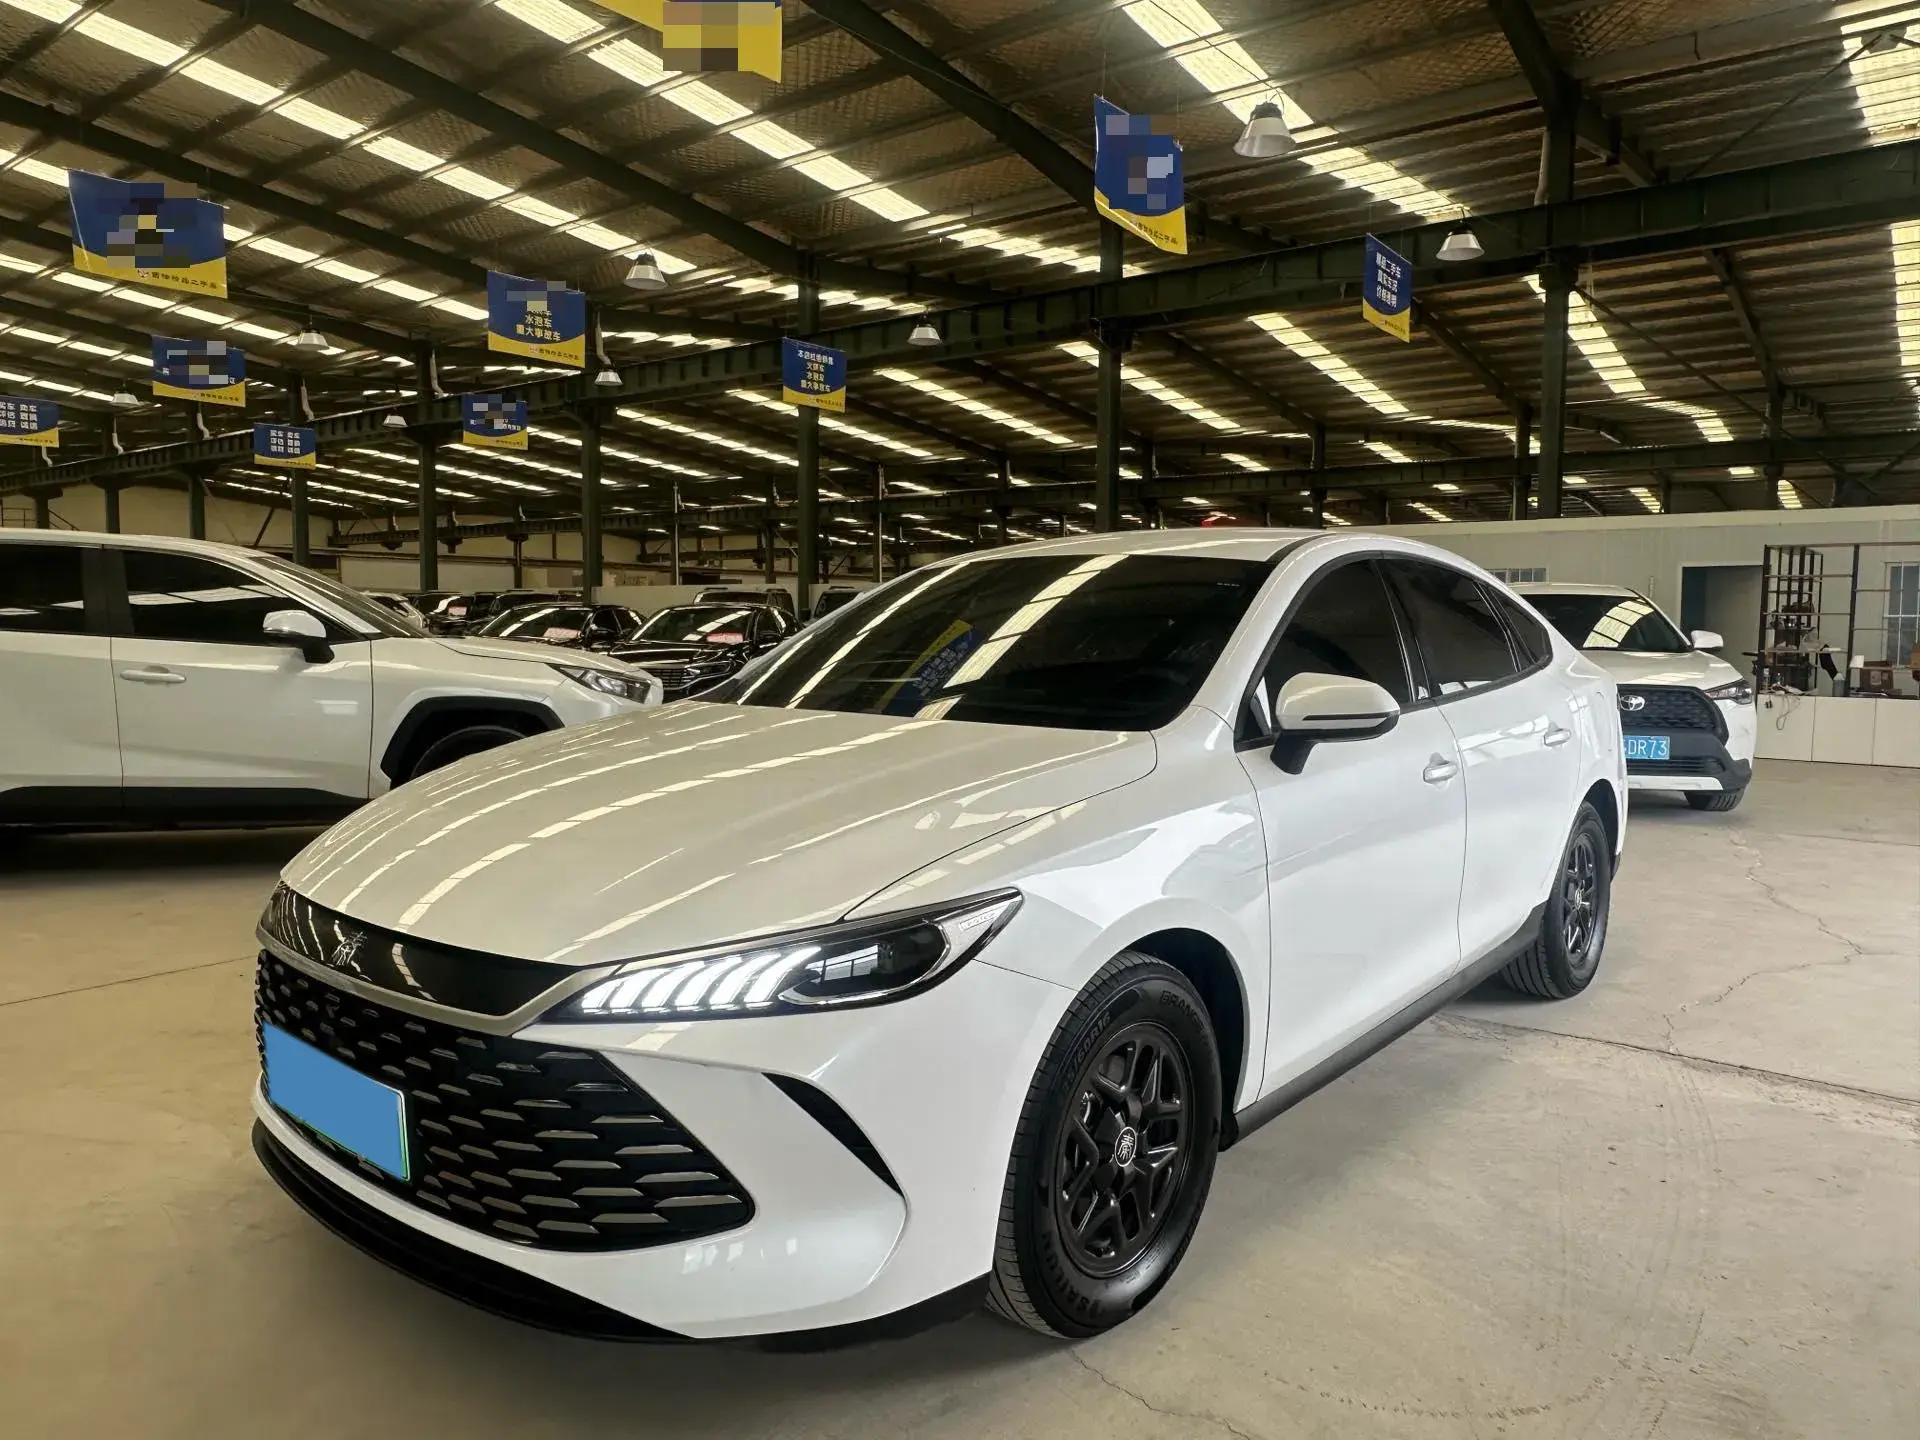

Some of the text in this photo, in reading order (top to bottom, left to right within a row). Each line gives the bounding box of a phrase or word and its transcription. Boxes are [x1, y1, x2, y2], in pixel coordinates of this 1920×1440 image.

[525, 314, 552, 328] 水泡车
[516, 324, 560, 341] 重大事故车
